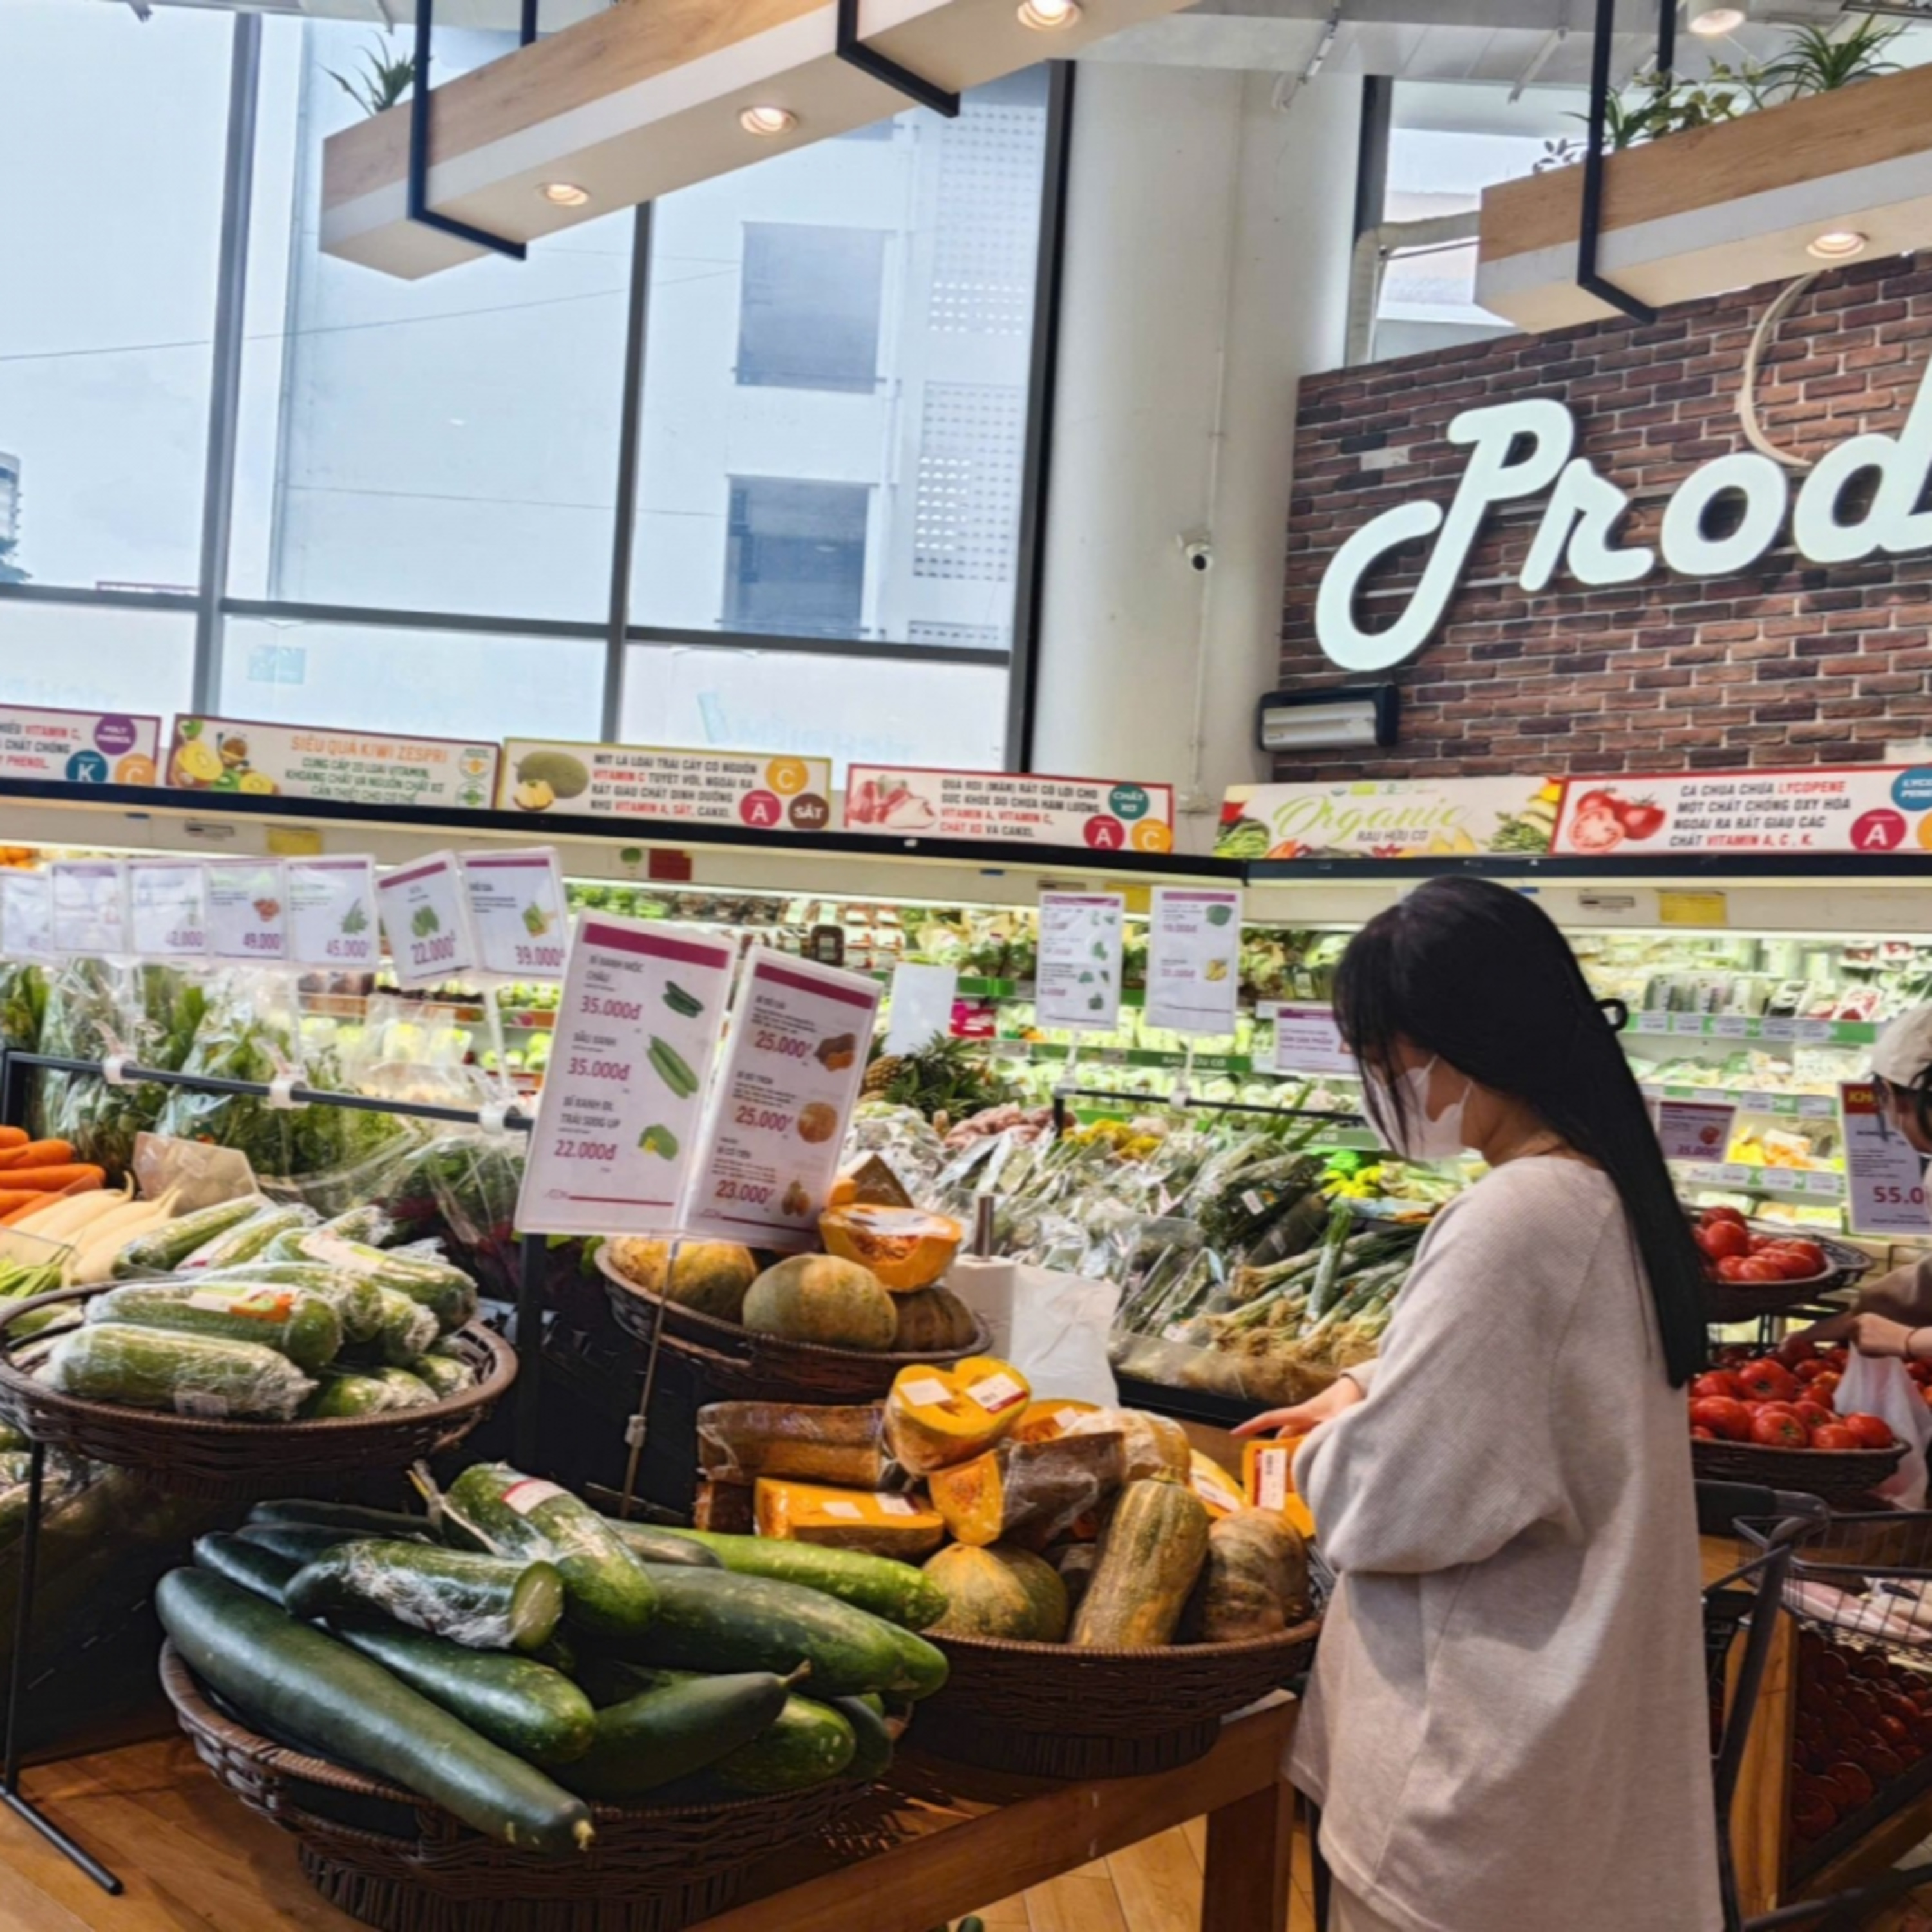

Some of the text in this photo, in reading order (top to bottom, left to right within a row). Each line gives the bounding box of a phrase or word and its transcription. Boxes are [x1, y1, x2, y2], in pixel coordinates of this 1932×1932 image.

[1315, 356, 1932, 672] Prod
[361, 743, 392, 758] KIWI
[399, 746, 448, 763] ZESPRI
[77, 763, 97, 782] K
[593, 769, 635, 781] VITAMIN
[638, 772, 645, 782] C
[777, 768, 793, 790] C
[670, 790, 694, 800] DINH
[1077, 788, 1098, 799] CHO
[1701, 784, 1736, 797] CHUA
[1778, 780, 1846, 795] LYCOPENE
[615, 801, 657, 813] VITAMIN
[750, 804, 768, 822] A
[1794, 799, 1819, 811] OXY
[940, 808, 982, 819] VITAMIN
[999, 811, 1040, 823] VITAMIN
[1273, 793, 1473, 844] Organic
[1714, 817, 1731, 829] RA
[1095, 828, 1113, 846] A
[1141, 830, 1160, 850] C
[1357, 829, 1381, 842] RAU
[1707, 835, 1759, 847] VITAMIN
[1863, 824, 1887, 846] A
[580, 995, 642, 1020] 35.000đ
[567, 1057, 630, 1080] 35.000đ
[554, 1139, 618, 1161] 22.000đ
